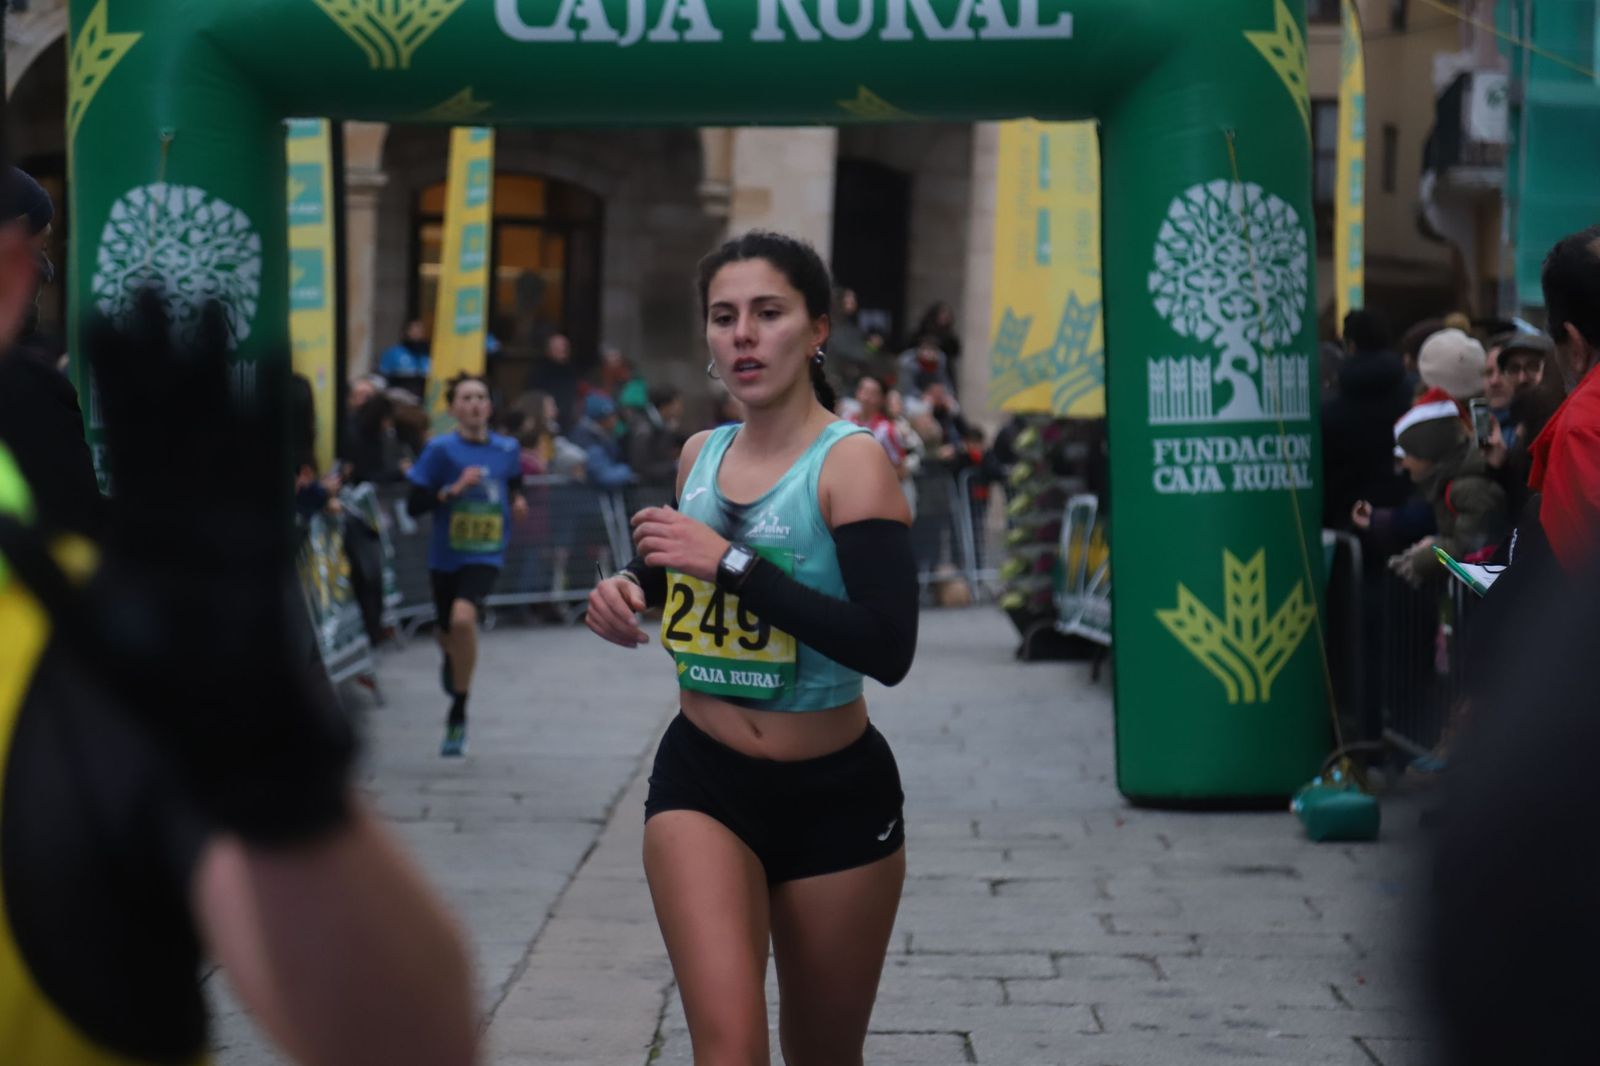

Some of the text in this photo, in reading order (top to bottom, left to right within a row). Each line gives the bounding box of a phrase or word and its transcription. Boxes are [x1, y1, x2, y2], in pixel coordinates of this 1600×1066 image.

[1153, 462, 1313, 494] CAJA RURAL
[666, 582, 771, 651] 249
[689, 664, 784, 689] CAJA RURAL
